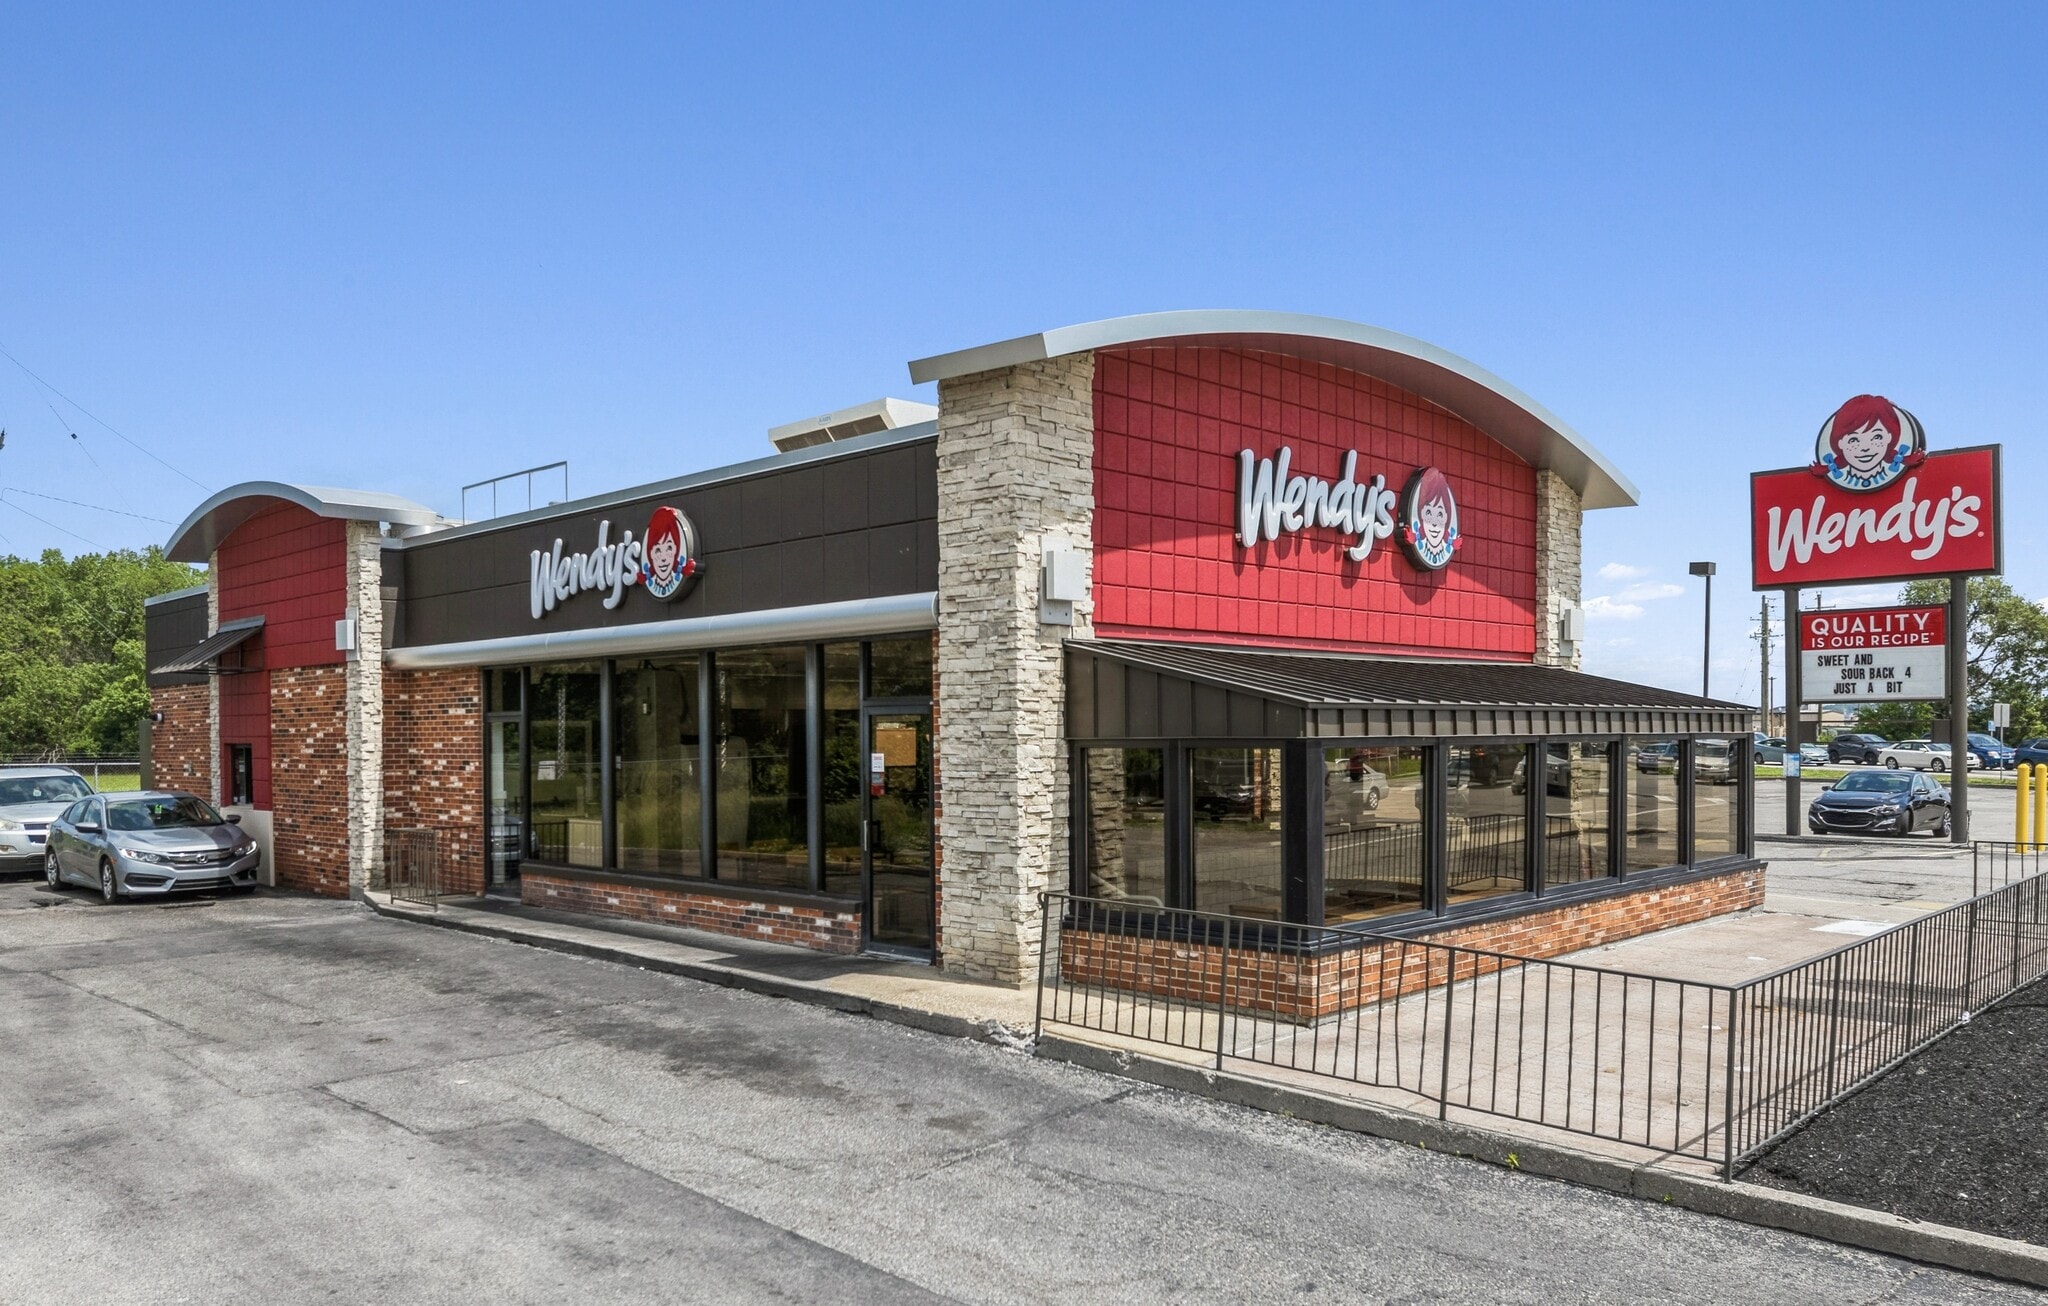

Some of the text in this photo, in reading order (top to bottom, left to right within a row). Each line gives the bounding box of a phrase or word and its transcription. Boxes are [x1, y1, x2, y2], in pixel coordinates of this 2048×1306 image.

[1240, 445, 1396, 562] Wendy's
[1768, 476, 1982, 573] Wendy's
[530, 519, 641, 620] Wendy's
[1810, 612, 1930, 636] QUALITY
[1811, 633, 1931, 648] IS OUR RECIPE
[1817, 653, 1873, 667] SWEET AND
[1841, 666, 1912, 680] SOUR BACK 4
[1833, 681, 1903, 694] JUST A BIT
